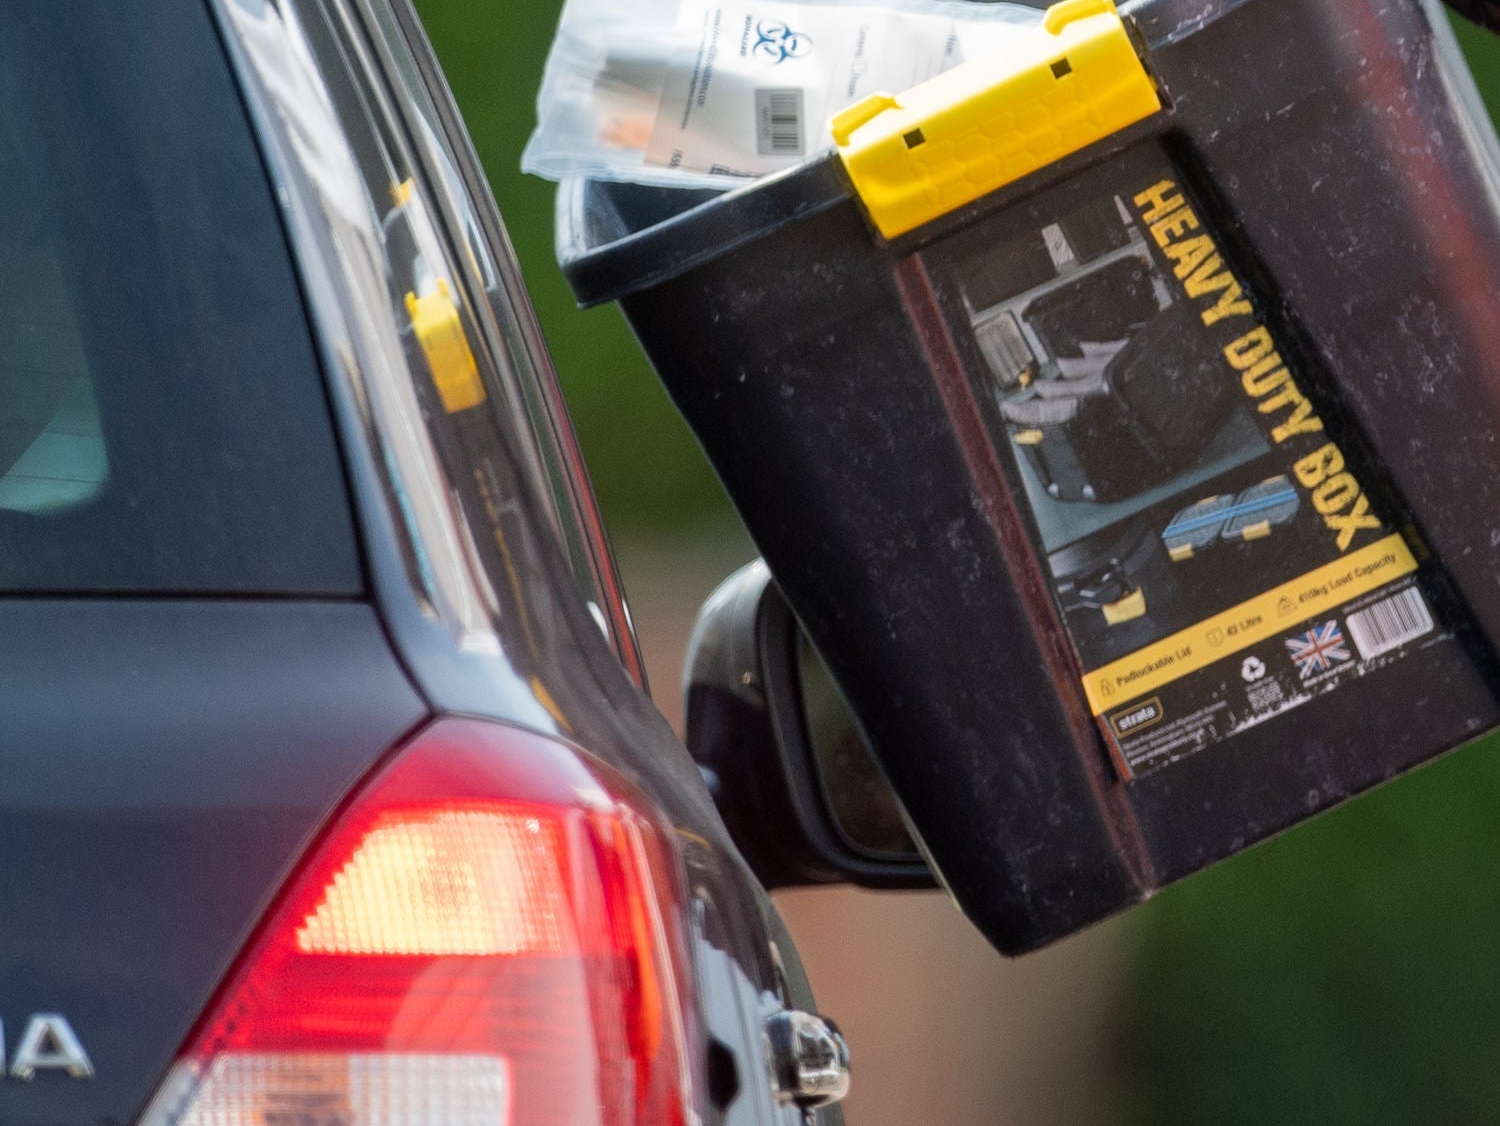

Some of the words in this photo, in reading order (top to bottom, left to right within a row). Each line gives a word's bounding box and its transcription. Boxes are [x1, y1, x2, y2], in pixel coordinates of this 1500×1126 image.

[1133, 178, 1253, 326] HEAVY
[1223, 324, 1324, 443] DUTY
[1292, 441, 1381, 552] BOX
[1329, 571, 1354, 591] Load
[1354, 552, 1397, 580] Capacity
[1115, 655, 1175, 687] Padlockable
[1176, 647, 1193, 662] Lid
[1117, 706, 1157, 732] strata
